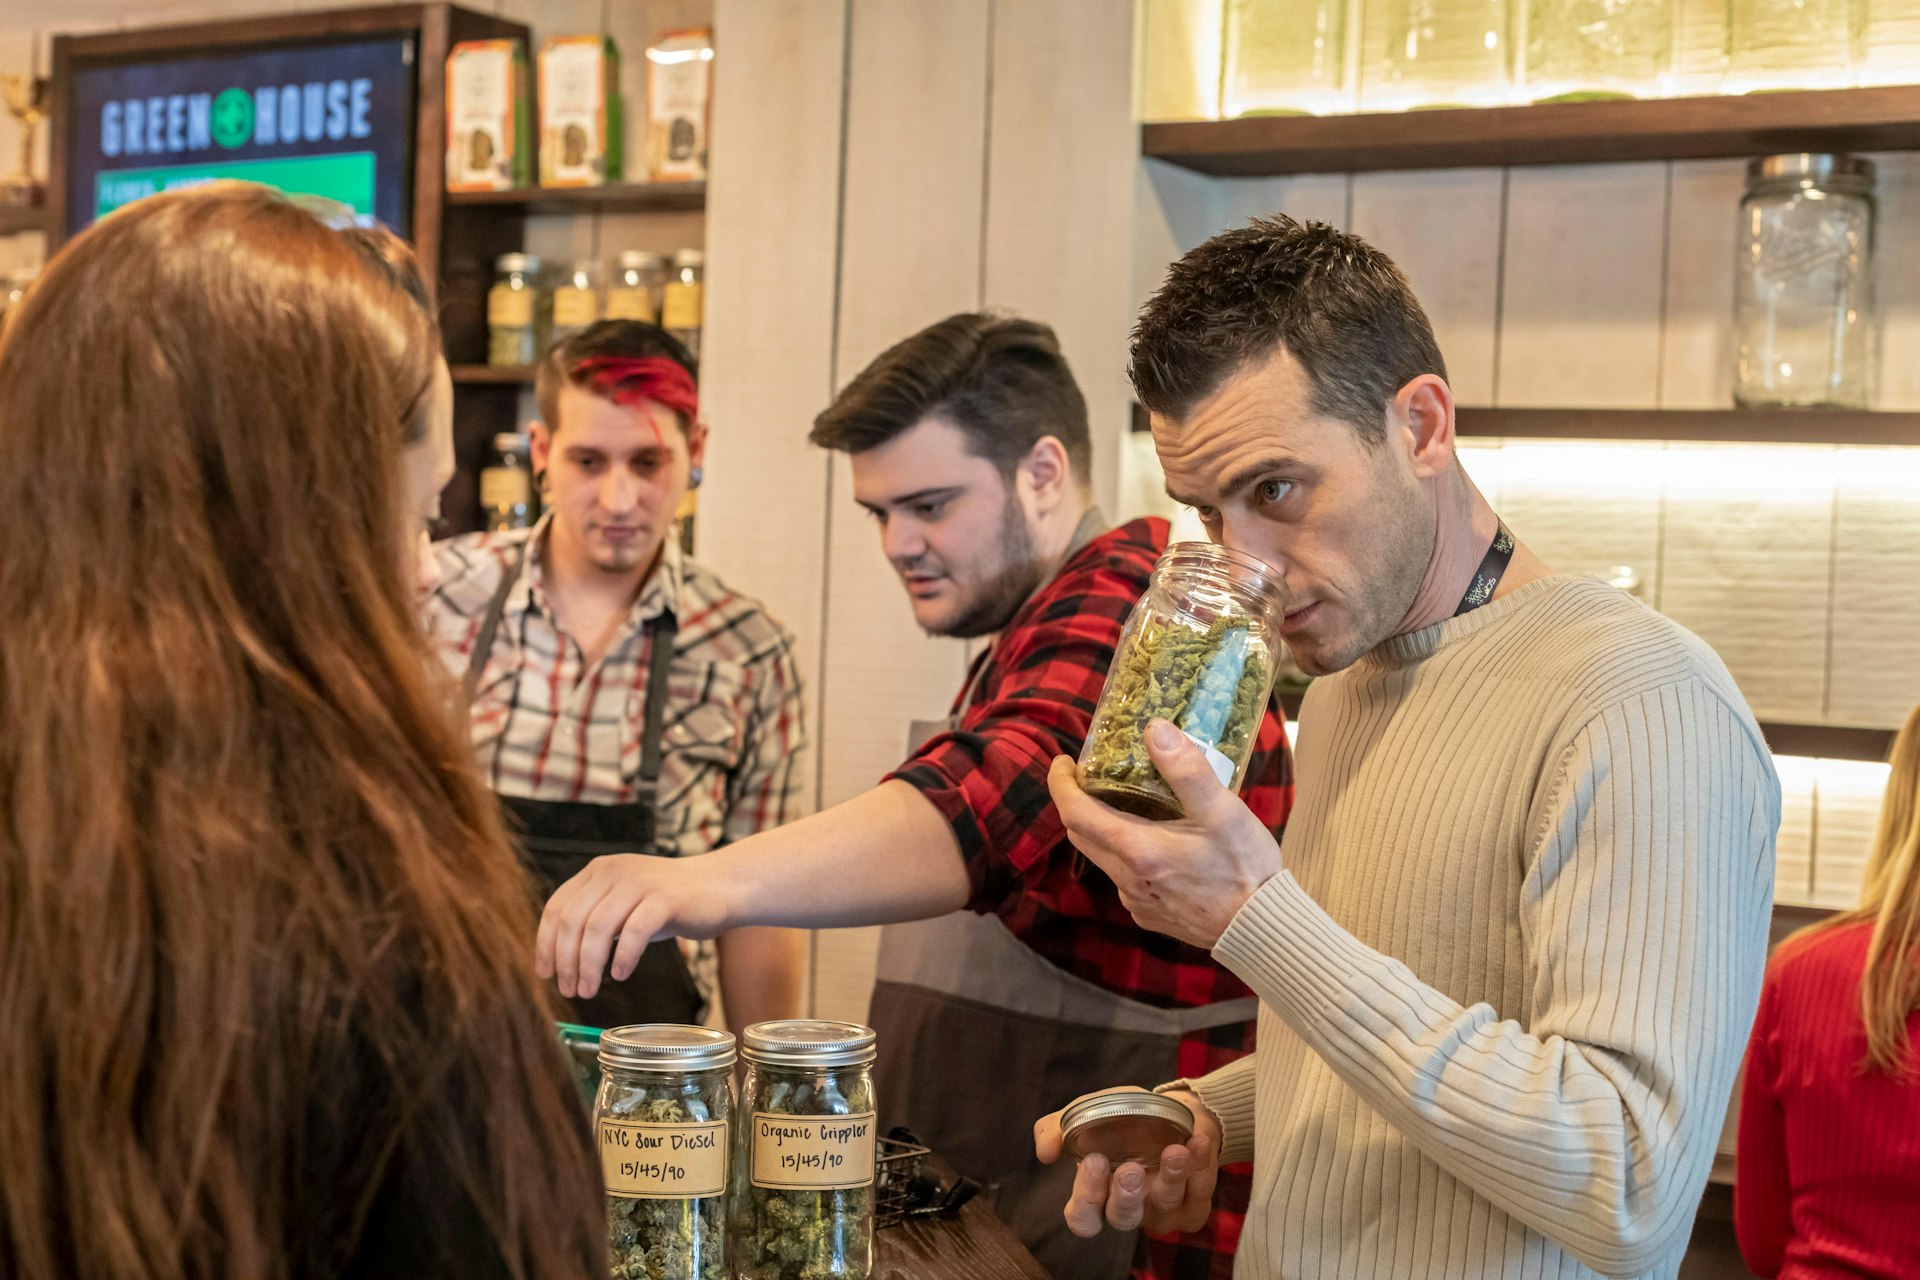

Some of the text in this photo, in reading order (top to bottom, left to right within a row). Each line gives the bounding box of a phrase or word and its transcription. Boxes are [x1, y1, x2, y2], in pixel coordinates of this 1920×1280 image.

[101, 78, 373, 157] GREEN HOUSE
[604, 1128, 715, 1150] NYC Sour Diesel
[761, 1122, 869, 1147] Organic Crippler
[620, 1161, 685, 1182] 15/45/90
[781, 1150, 843, 1172] 15/45/90
